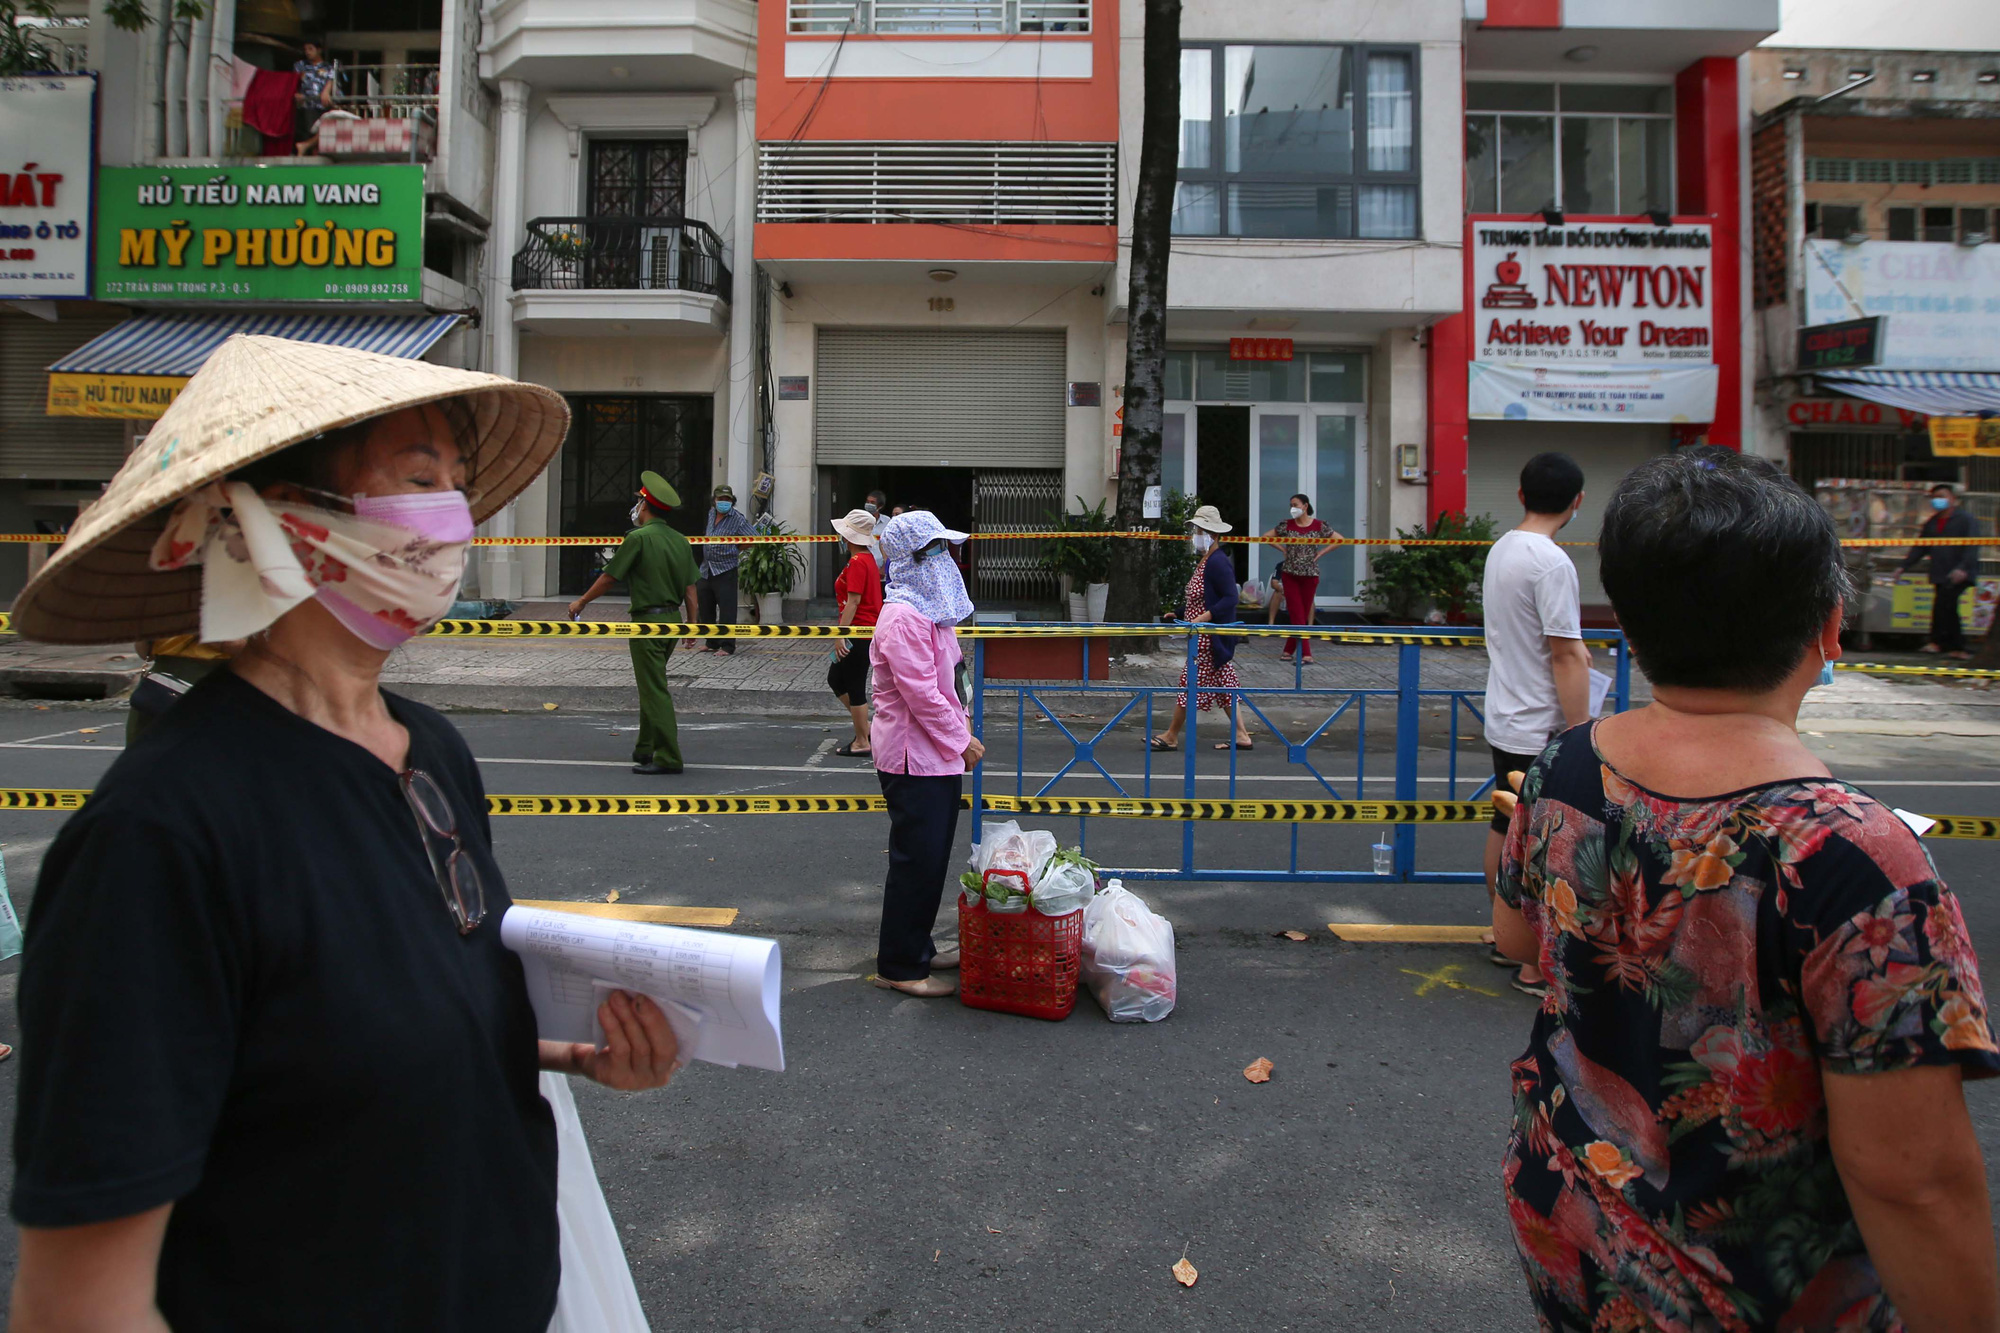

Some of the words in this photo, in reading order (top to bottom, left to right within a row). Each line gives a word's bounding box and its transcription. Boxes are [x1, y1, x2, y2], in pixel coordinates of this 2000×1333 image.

[138, 175, 171, 204] HỦ
[180, 175, 238, 204] TIẾU
[247, 184, 304, 204] NAM
[312, 183, 379, 204] VANG
[55, 220, 80, 239] TÔ
[1480, 229, 1530, 247] TRUNG
[119, 219, 191, 266] MỸ
[202, 218, 395, 266] PHƯƠNG
[345, 283, 368, 294] 0909
[371, 283, 388, 294] 892
[391, 283, 409, 294] 758
[1543, 264, 1706, 308] NEWTON
[1488, 318, 1571, 345] Achieve
[1579, 319, 1628, 346] Your
[1640, 320, 1708, 346] Dream
[1816, 346, 1856, 366] 162
[139, 386, 172, 405] NAM
